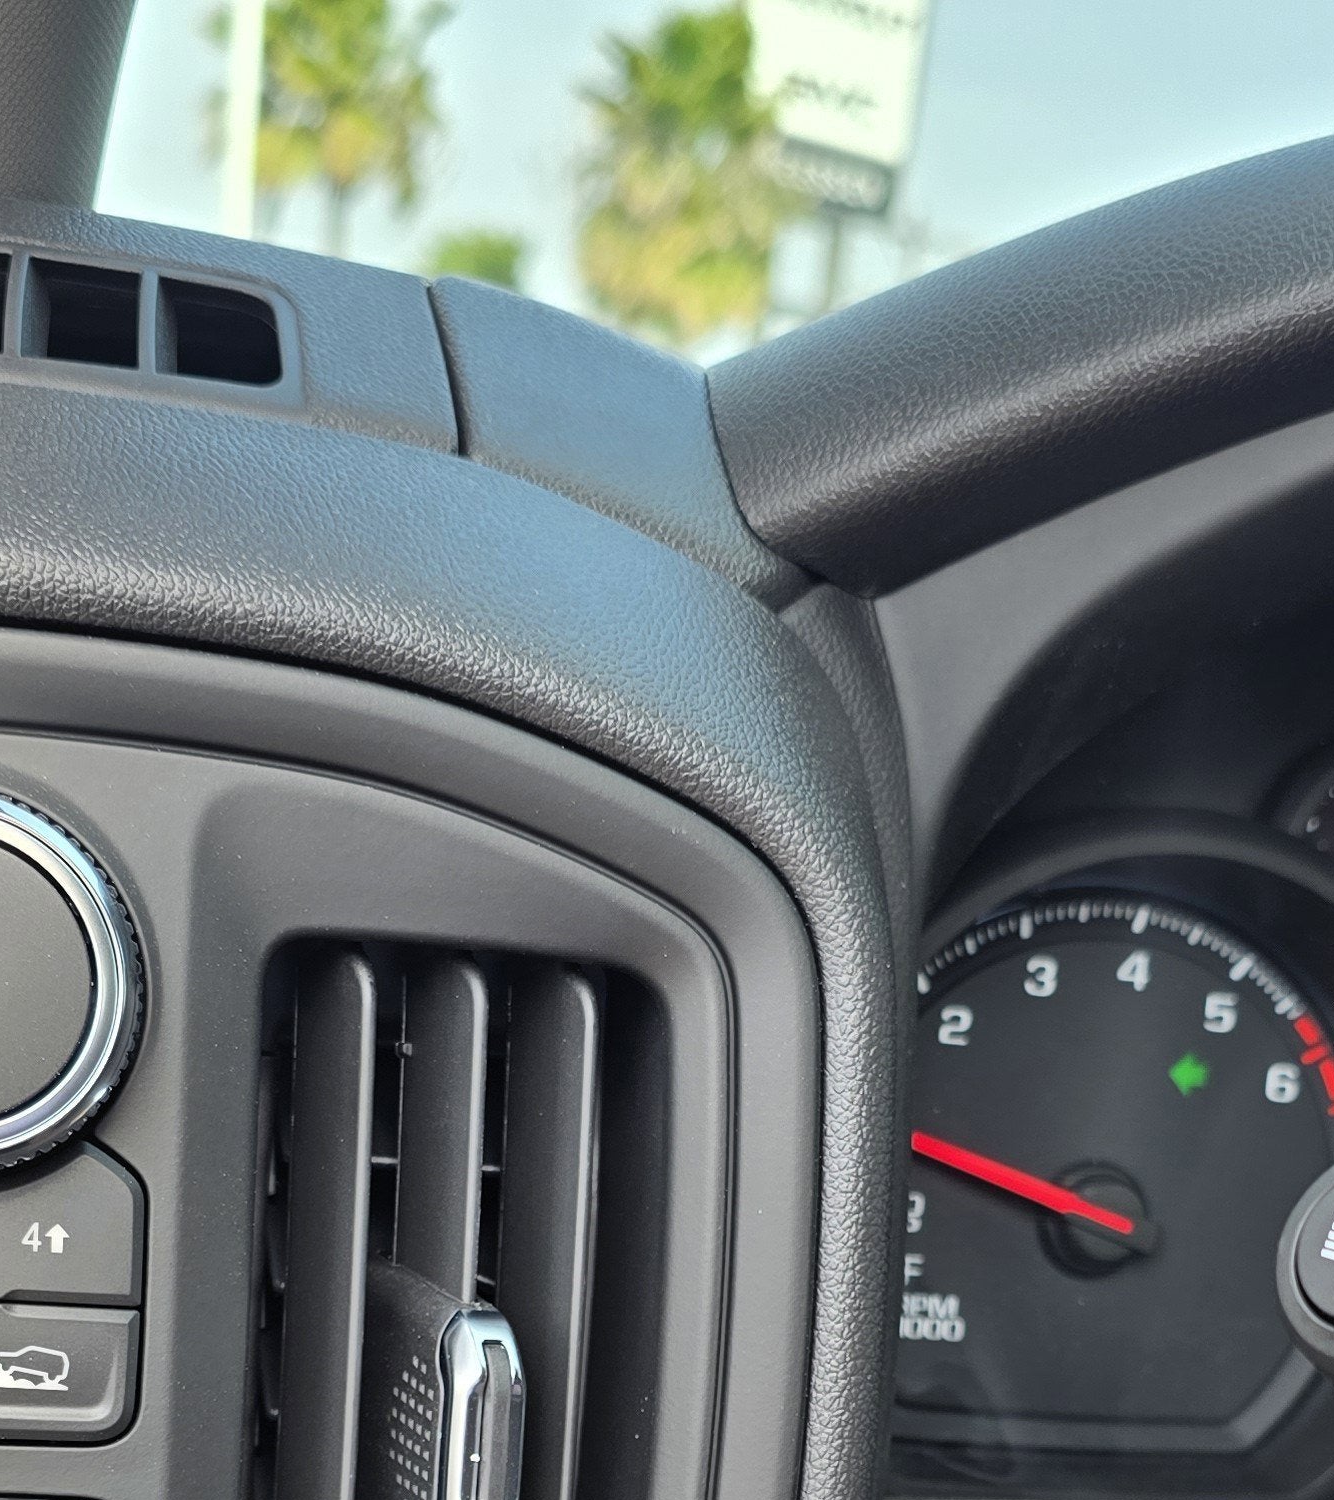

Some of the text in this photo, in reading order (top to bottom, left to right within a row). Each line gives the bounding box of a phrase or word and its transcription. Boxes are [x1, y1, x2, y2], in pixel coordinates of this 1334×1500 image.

[1024, 954, 1059, 997] 3
[1117, 950, 1152, 992] 4
[938, 1004, 974, 1047] 2
[1203, 991, 1238, 1034] 5
[1264, 1061, 1301, 1104] 6
